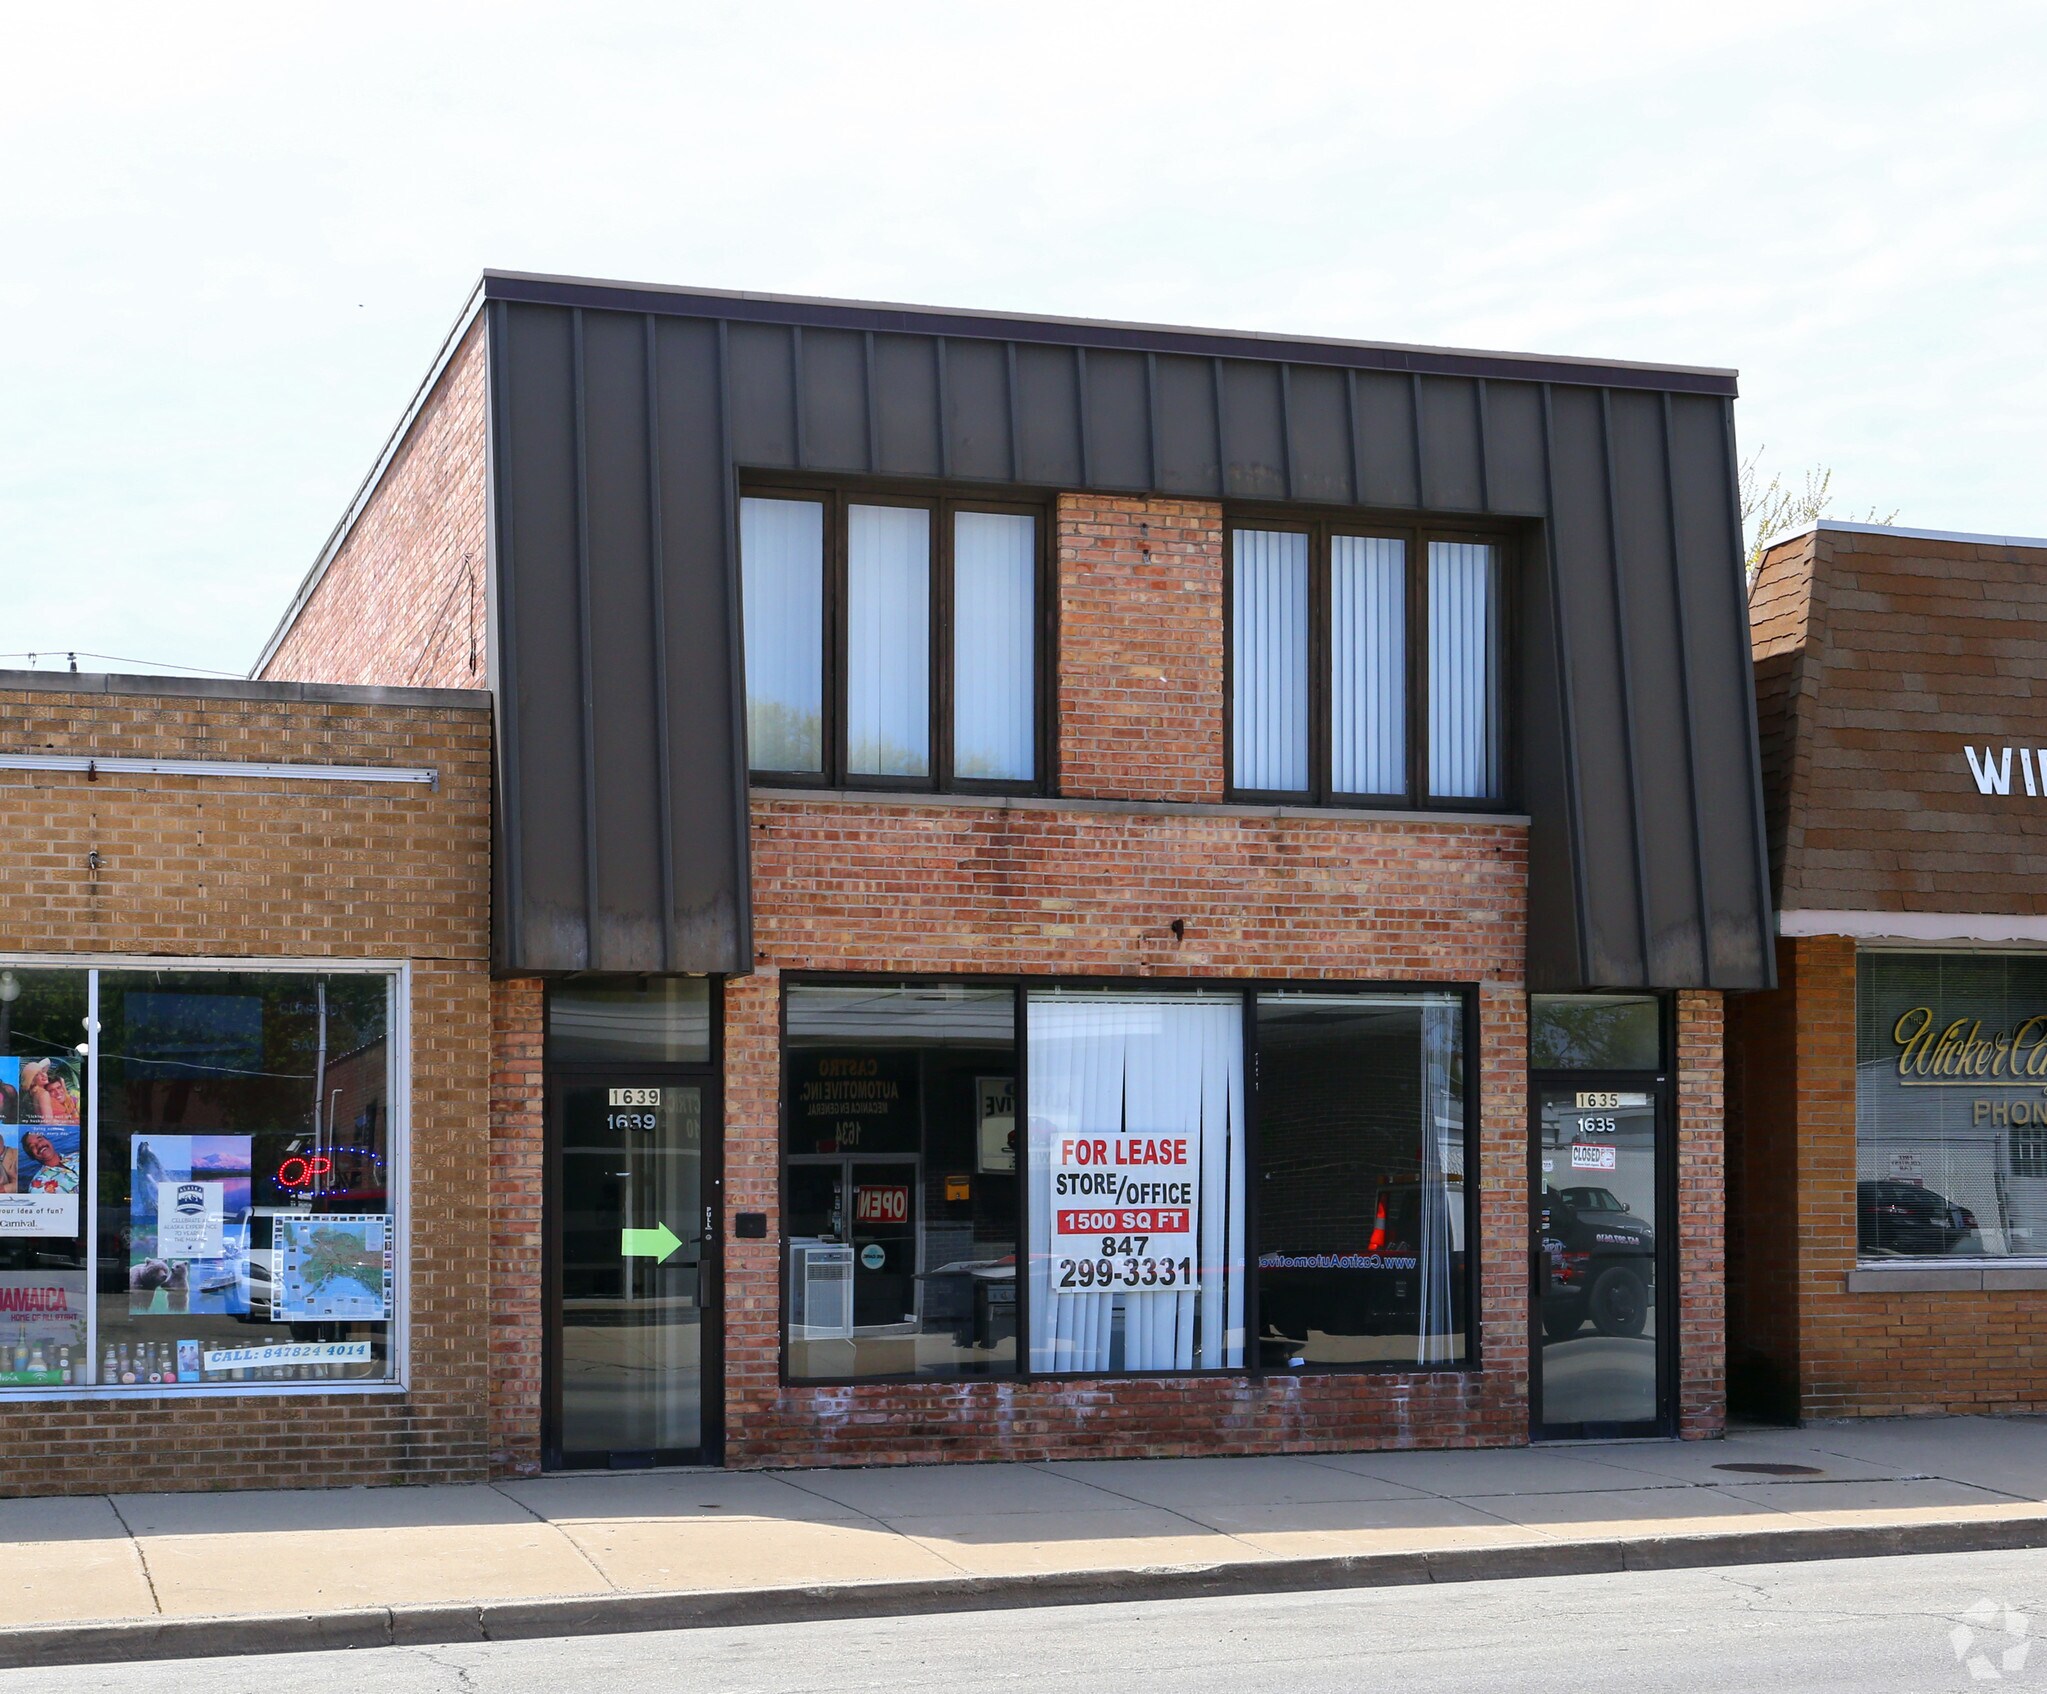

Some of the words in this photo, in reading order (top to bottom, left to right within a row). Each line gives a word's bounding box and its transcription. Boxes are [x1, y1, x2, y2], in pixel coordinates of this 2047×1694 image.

[1894, 1007, 2009, 1076] Wicker
[612, 1089, 659, 1105] 1639
[1579, 1093, 1618, 1107] 1635
[607, 1113, 656, 1130] 1639
[1577, 1117, 1616, 1132] 1635
[1062, 1139, 1108, 1165] FOR
[1115, 1139, 1187, 1165] LEASE
[1573, 1146, 1601, 1163] CLOSED
[1056, 1172, 1192, 1205] STORE/OFFICE
[1065, 1212, 1116, 1230] 1500
[1122, 1211, 1152, 1230] SQ
[1158, 1211, 1183, 1229] FT
[1101, 1236, 1149, 1257] 847
[1060, 1256, 1191, 1287] 299-3331
[11, 1314, 30, 1322] HOME
[211, 1351, 260, 1363] CALL:
[326, 1344, 366, 1355] 4014
